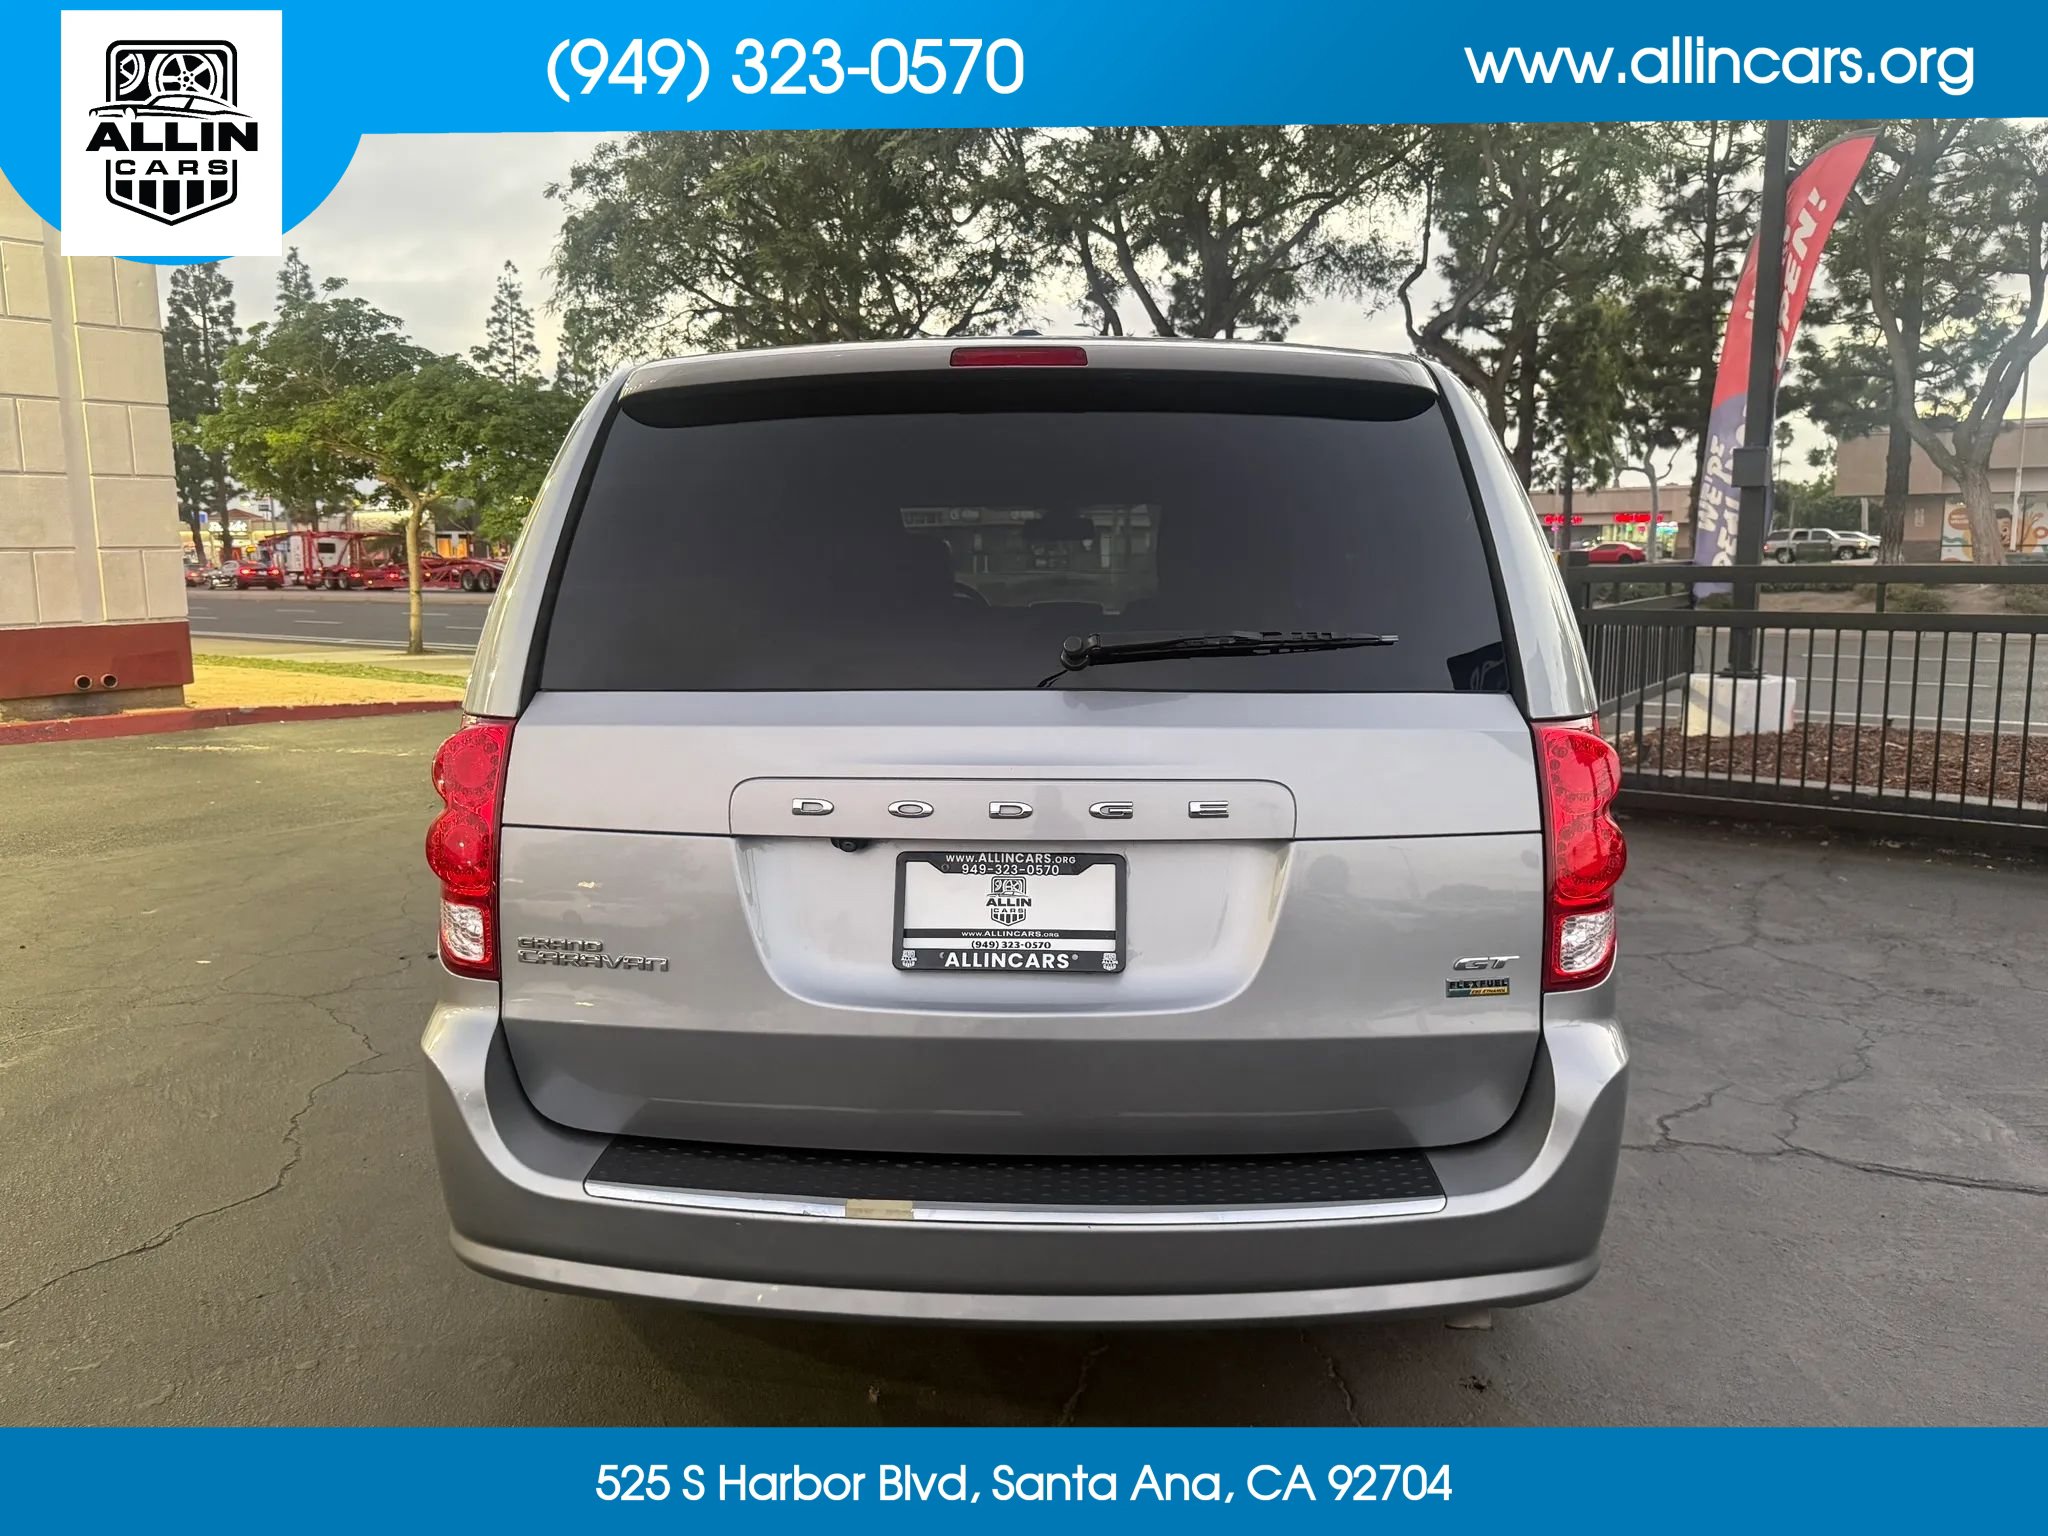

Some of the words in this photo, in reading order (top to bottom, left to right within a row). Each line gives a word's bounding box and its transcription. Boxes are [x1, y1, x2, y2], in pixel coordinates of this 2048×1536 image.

[791, 797, 1229, 819] DODGE
[961, 864, 1060, 876] 949-323-0570
[985, 898, 1032, 908] ALLIN
[517, 936, 603, 952] GRAND
[971, 940, 999, 950] (949)
[1001, 941, 1052, 949] 323-0570
[517, 949, 670, 972] CARAVAN
[944, 952, 1070, 969] ALLINCARS
[1453, 955, 1520, 971] GT
